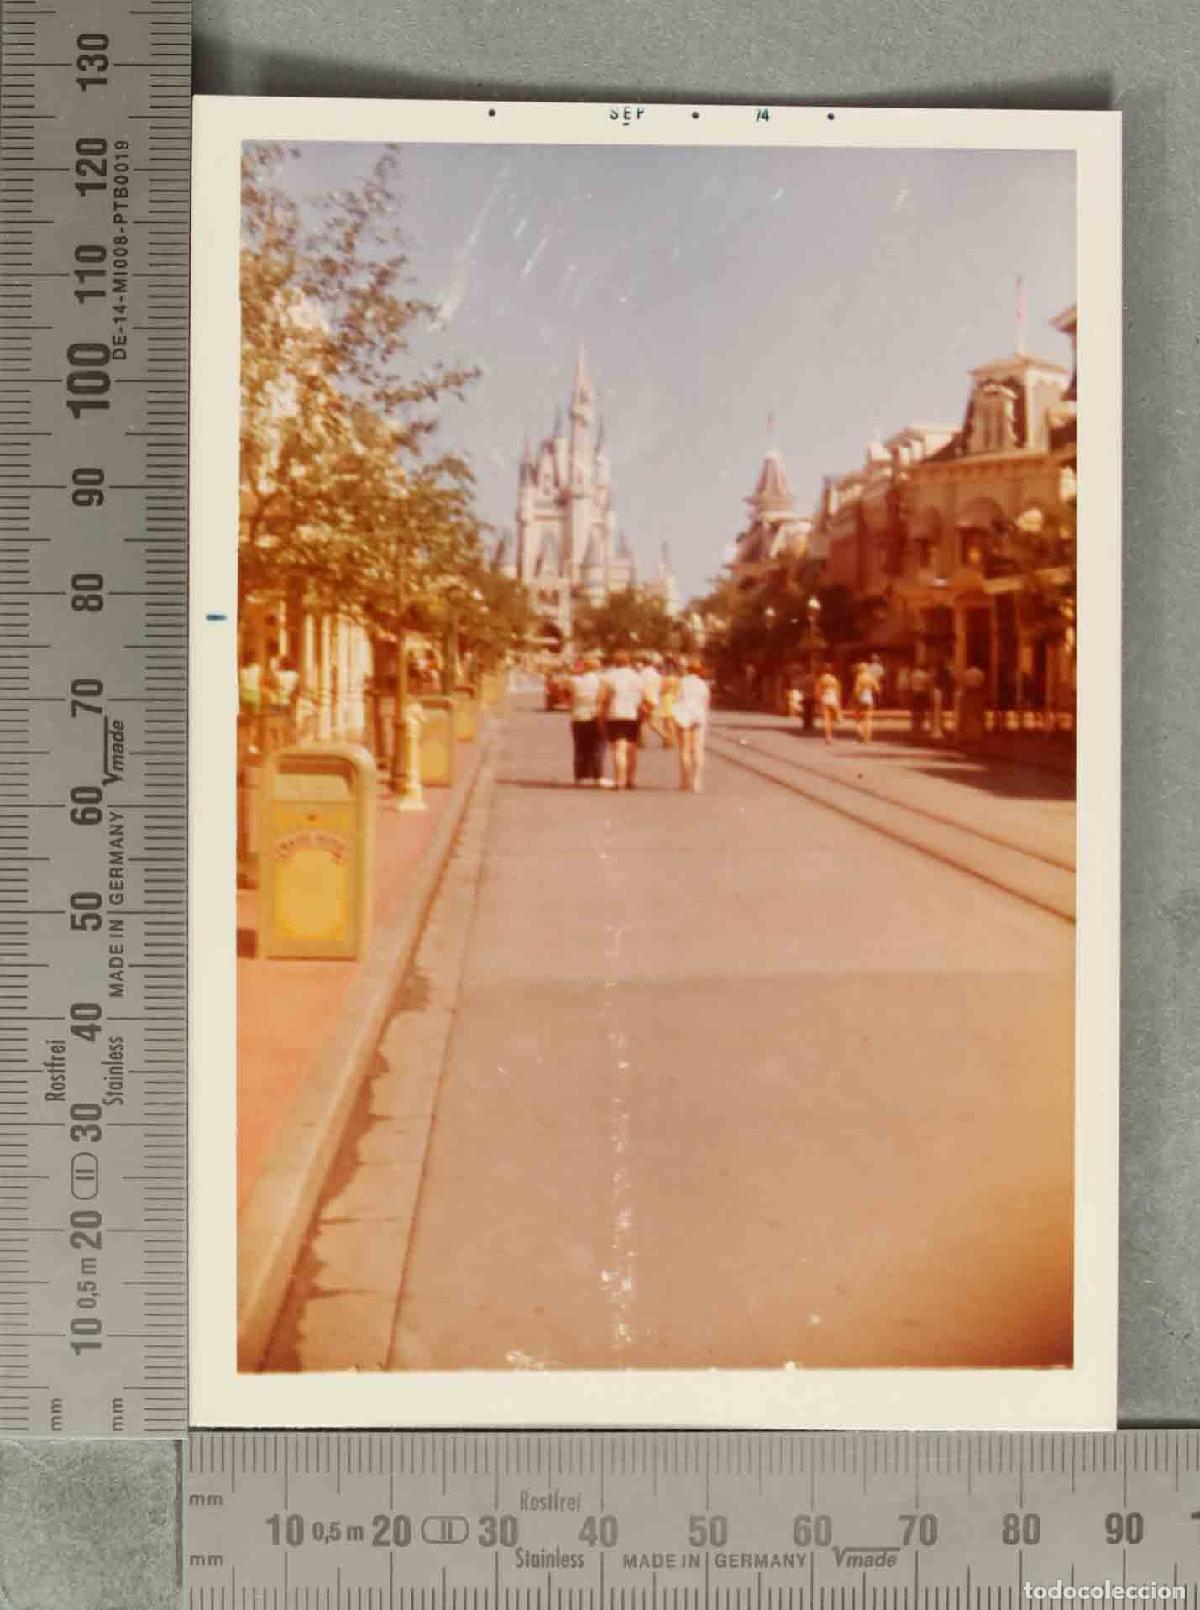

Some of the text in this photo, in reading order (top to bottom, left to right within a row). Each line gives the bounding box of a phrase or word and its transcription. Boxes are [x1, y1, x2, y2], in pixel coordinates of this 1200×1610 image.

[76, 33, 110, 92] 130
[75, 137, 108, 197] 120
[74, 244, 107, 304] 110
[66, 343, 112, 420] 100
[71, 468, 105, 507] 90
[71, 573, 103, 612] 80
[71, 679, 103, 718] 70
[70, 786, 103, 826] 60
[70, 892, 103, 932] 50
[109, 811, 125, 998] MADE IN GERMANY
[70, 1003, 103, 1042] 40
[45, 1040, 66, 1101] Rostfrei
[101, 1036, 124, 1105] Stainless
[70, 1103, 102, 1143] 30
[70, 1210, 102, 1250] 20
[70, 1317, 102, 1356] 10
[51, 1398, 62, 1432] mm
[112, 1398, 123, 1432] mm
[190, 1493, 223, 1506] mm
[520, 1490, 582, 1513] Rostfrei
[266, 1513, 304, 1547] 10
[371, 1513, 411, 1547] 20
[478, 1514, 518, 1547] 30
[578, 1514, 618, 1547] 40
[688, 1515, 728, 1547] 50
[793, 1514, 832, 1547] 60
[899, 1513, 938, 1546] 70
[1002, 1513, 1041, 1546] 80
[1104, 1512, 1144, 1545] 90
[190, 1554, 224, 1567] mm
[515, 1545, 585, 1569] Stainless
[623, 1553, 806, 1568] MADE IN GERMANY
